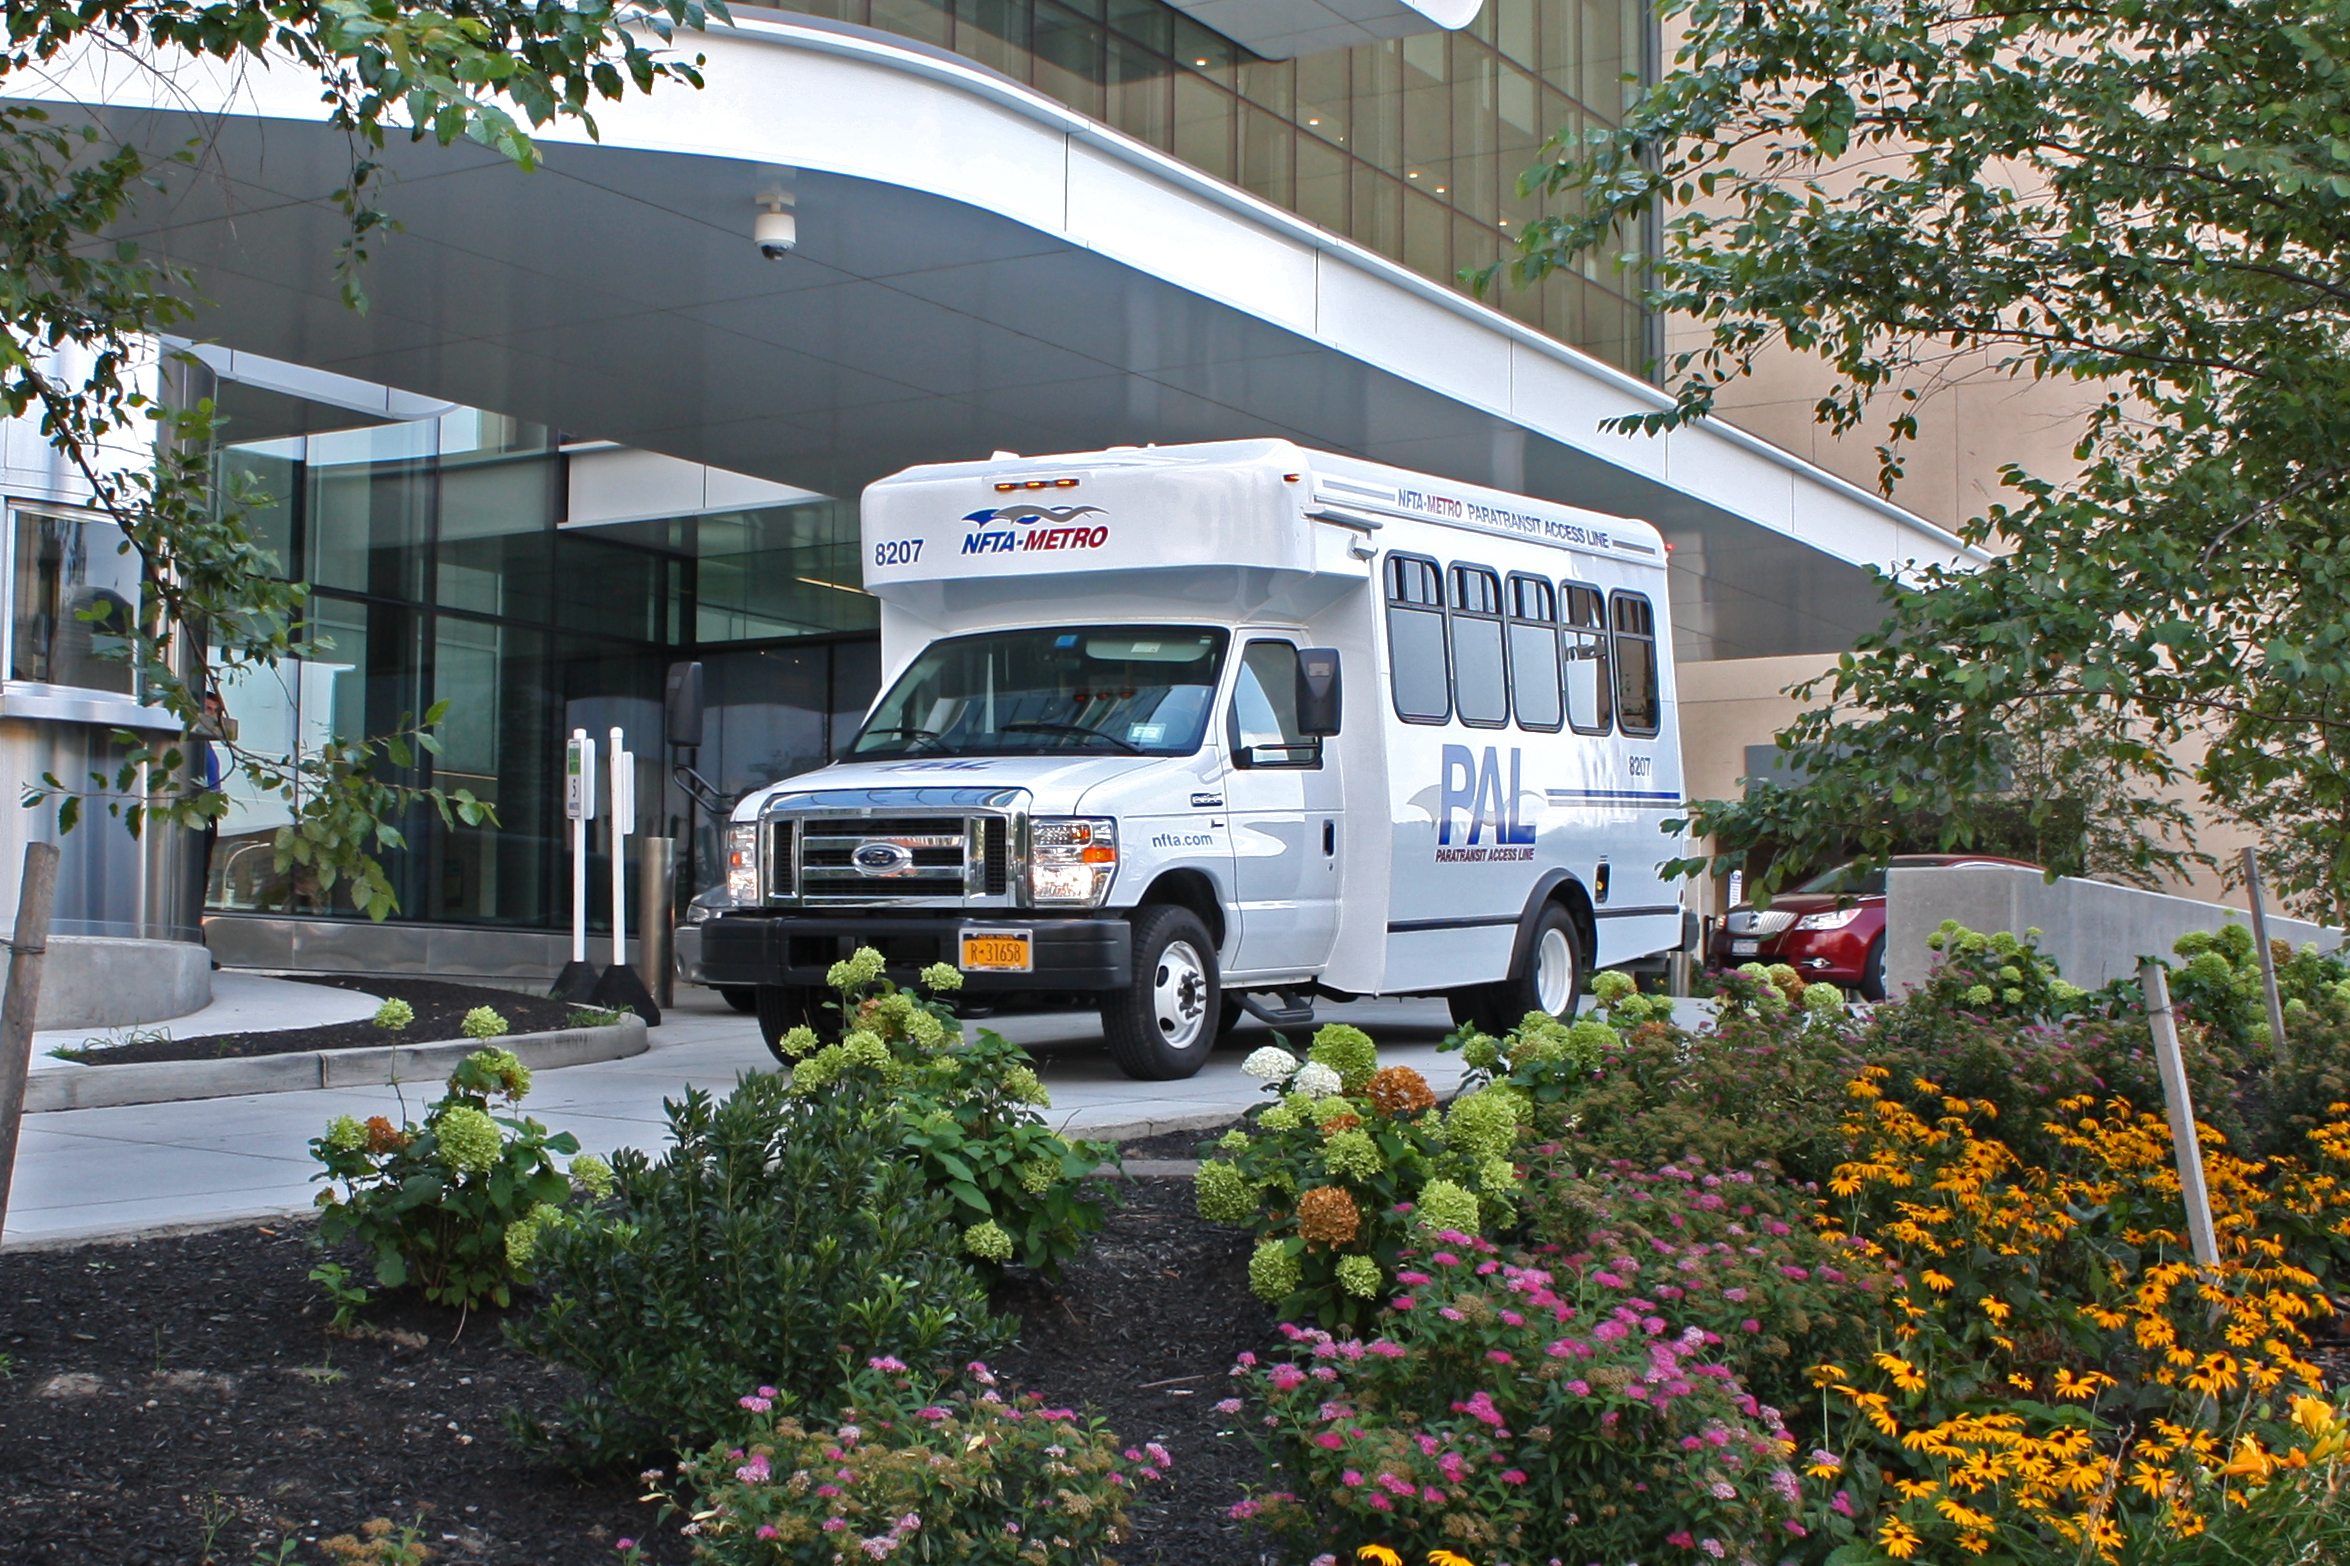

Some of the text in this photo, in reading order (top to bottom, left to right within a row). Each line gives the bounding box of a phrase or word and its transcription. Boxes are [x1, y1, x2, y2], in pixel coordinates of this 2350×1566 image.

[1467, 503, 1541, 534] PARATRANSIT
[1544, 520, 1585, 544] ACCESS
[1586, 531, 1609, 548] LINE
[875, 539, 923, 565] 8207
[961, 526, 1108, 554] NFTA-METRO
[1629, 755, 1650, 777] 8207
[1438, 744, 1536, 844] PAL
[1152, 836, 1214, 848] nfta.com
[1436, 846, 1535, 863] PARATRANSIT ACCESS LINE
